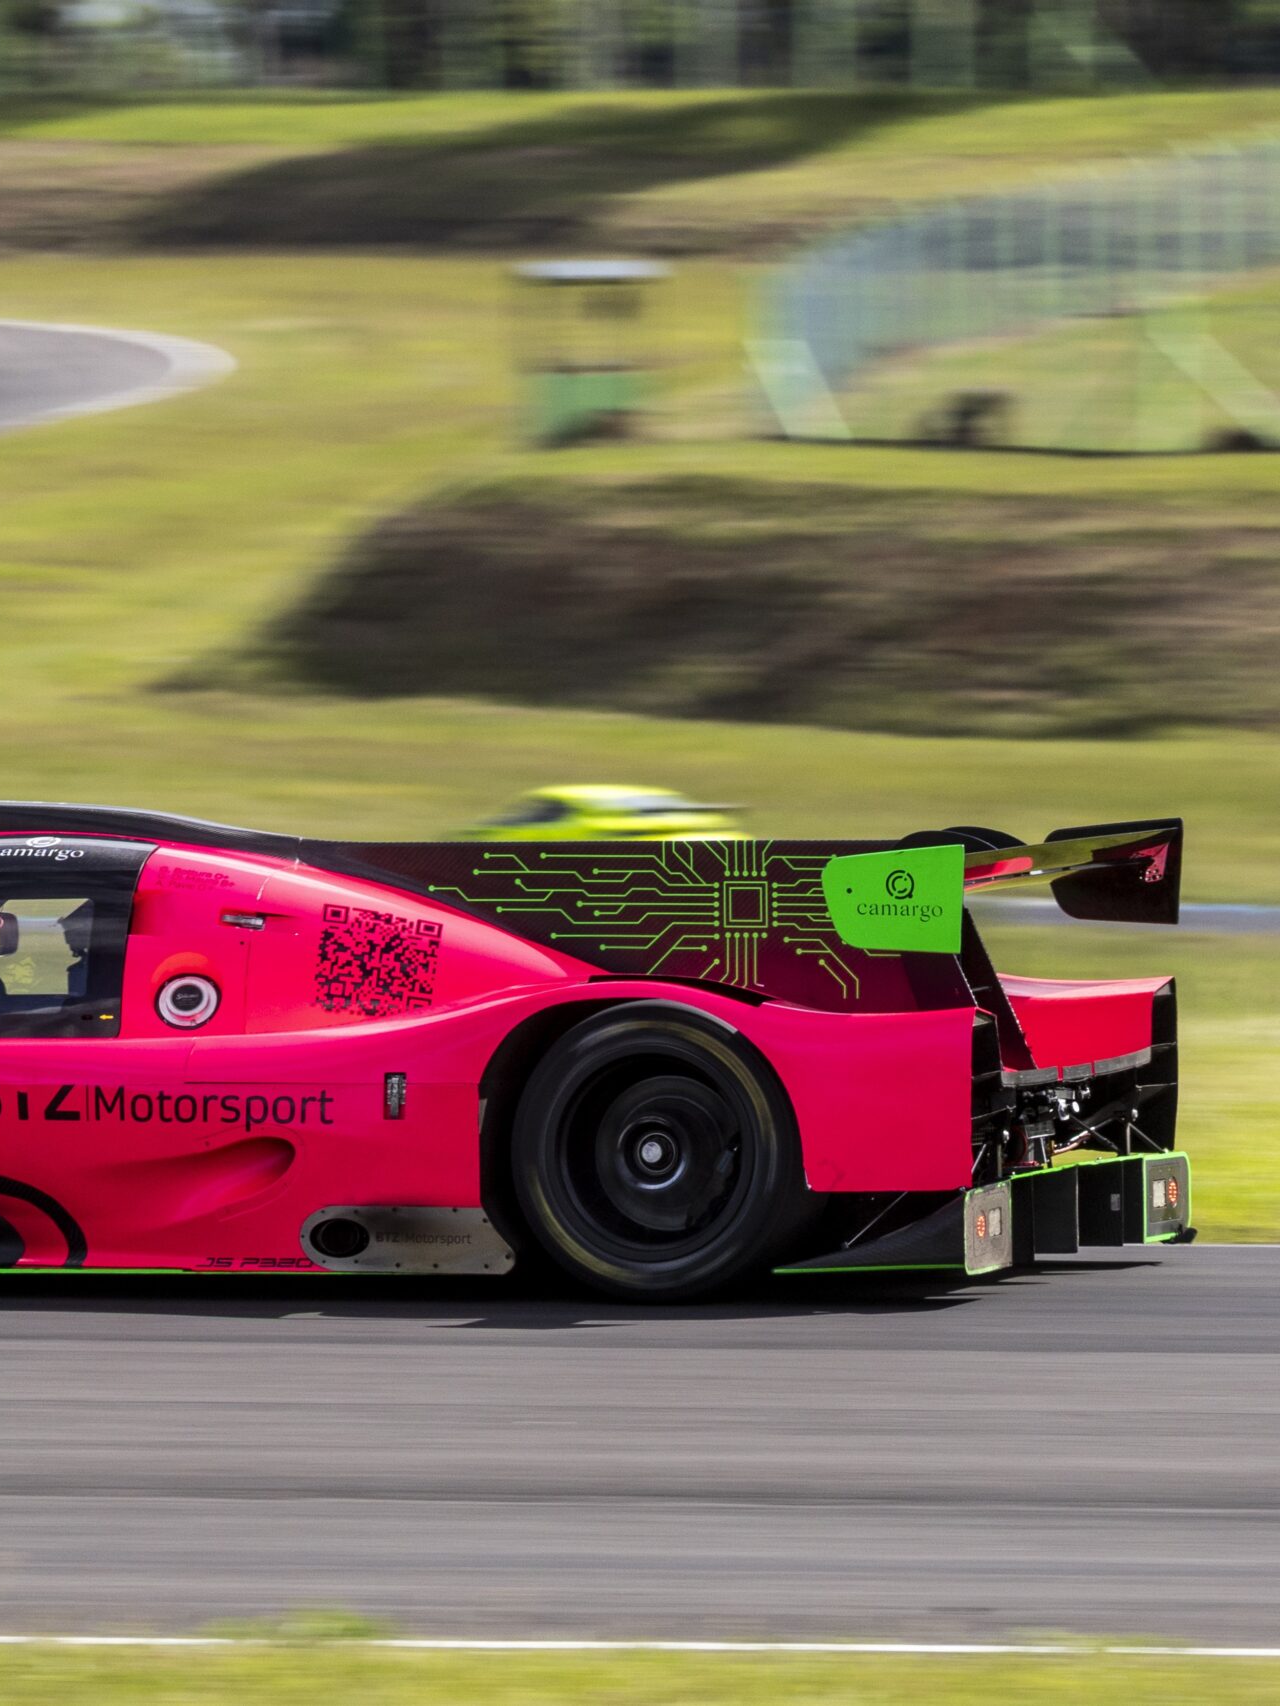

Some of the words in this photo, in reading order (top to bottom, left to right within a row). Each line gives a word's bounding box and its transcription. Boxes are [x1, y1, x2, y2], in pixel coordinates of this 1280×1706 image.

[856, 902, 943, 922] camargo
[95, 1085, 334, 1131] Motorsport
[375, 1232, 401, 1243] BTZ
[405, 1232, 473, 1246] Motorsport
